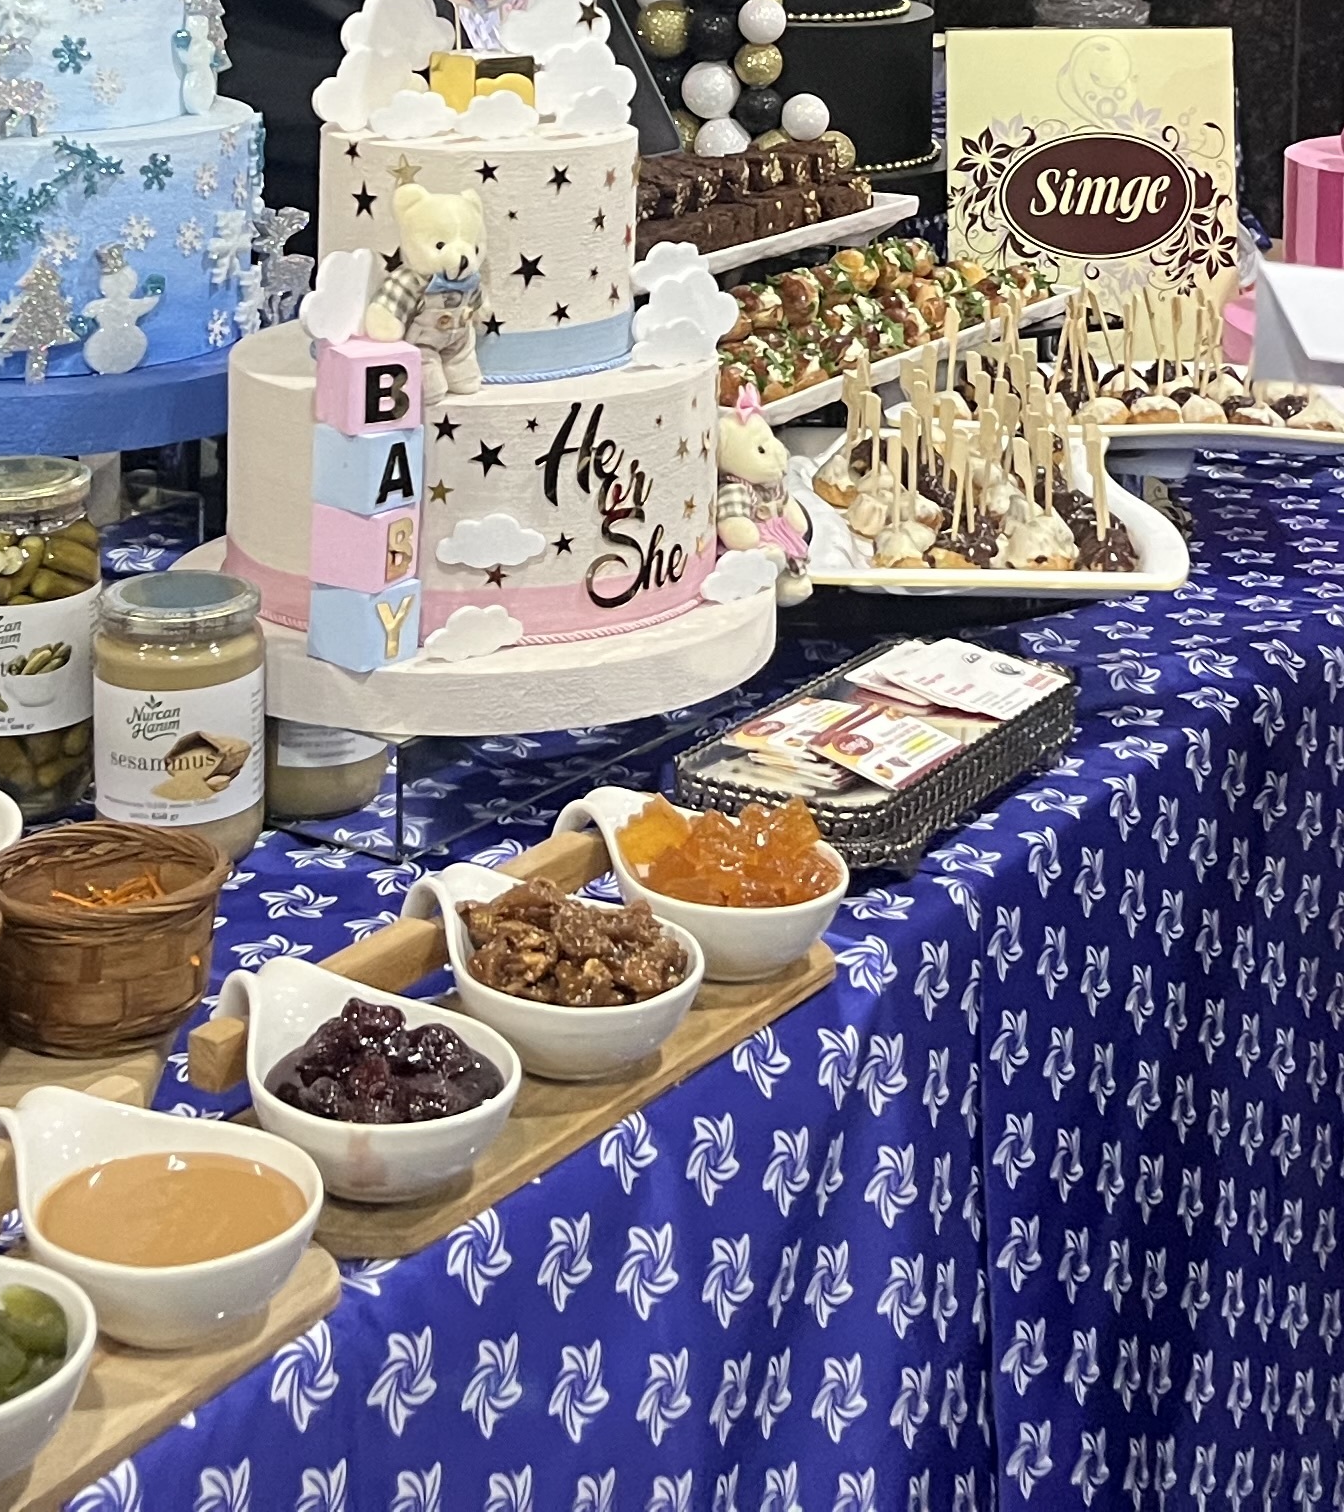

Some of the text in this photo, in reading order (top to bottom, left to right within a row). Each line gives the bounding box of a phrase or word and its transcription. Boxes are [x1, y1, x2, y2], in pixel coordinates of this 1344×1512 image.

[1029, 167, 1171, 221] Simge
[535, 402, 625, 507] He
[598, 459, 654, 516] or
[586, 506, 688, 609] She
[126, 706, 181, 724] Nurcan
[110, 751, 216, 772] sesammus
